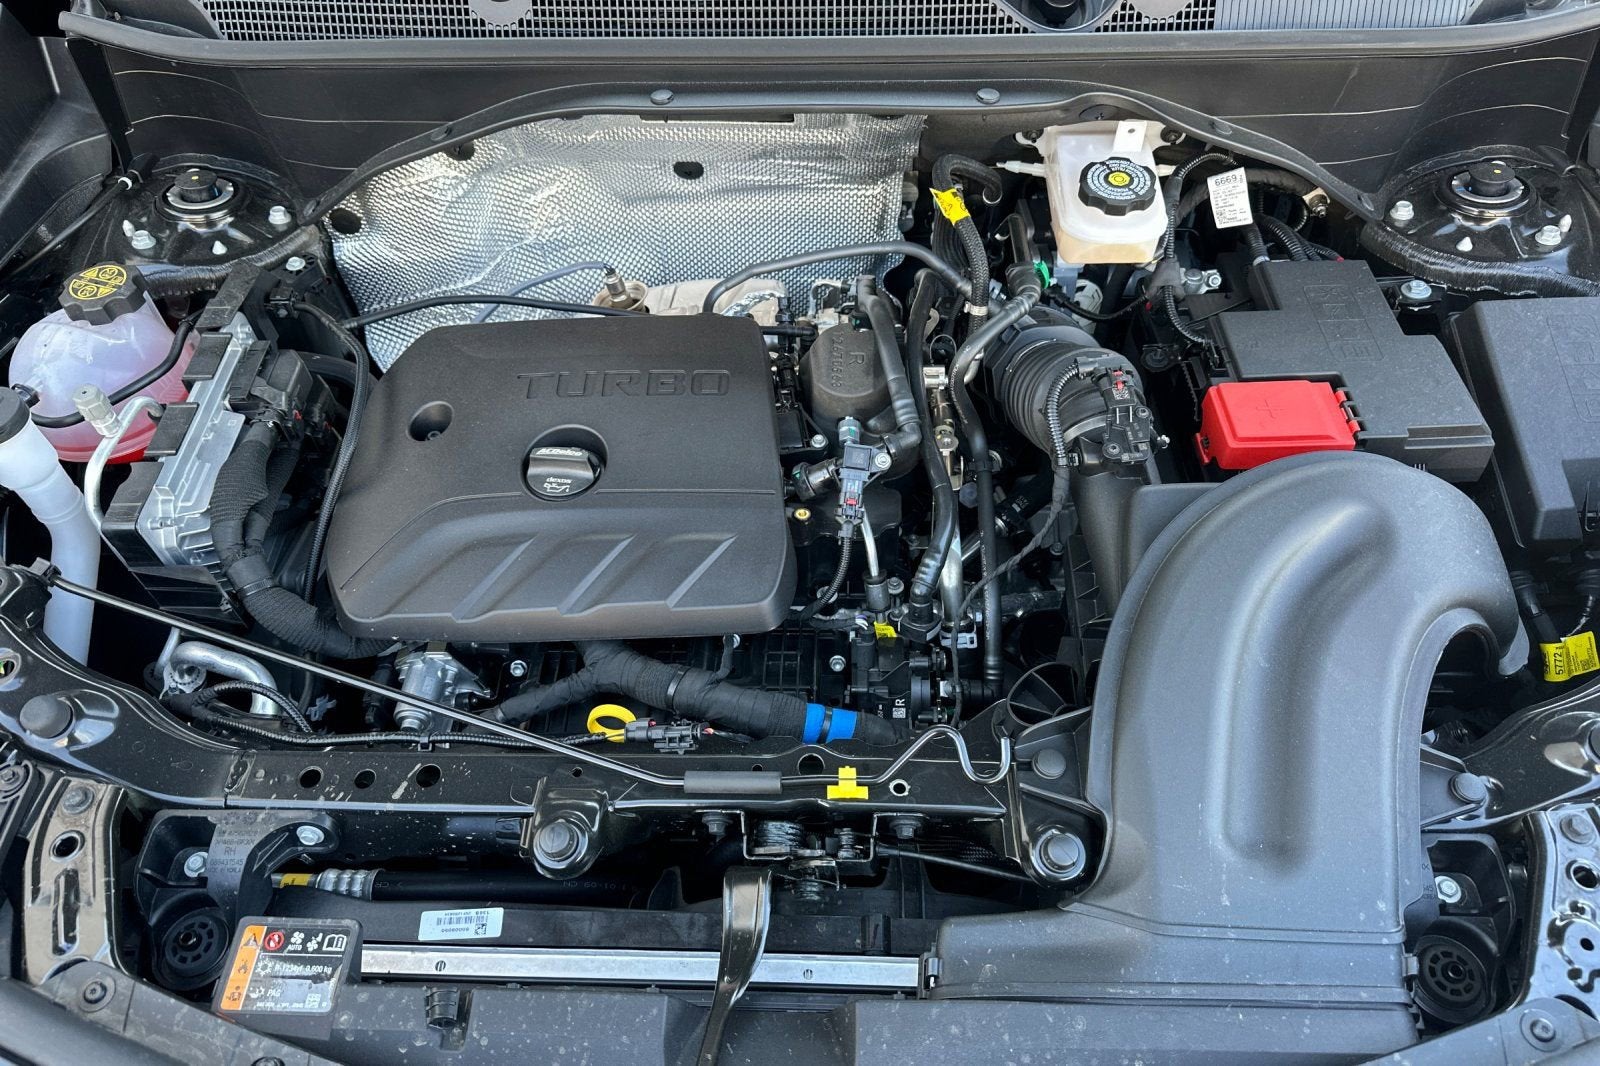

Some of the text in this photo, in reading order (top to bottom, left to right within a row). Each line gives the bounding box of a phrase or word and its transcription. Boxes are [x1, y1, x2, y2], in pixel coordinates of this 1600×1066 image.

[1215, 174, 1237, 187] 6669
[849, 352, 865, 365] R
[517, 369, 730, 399] TURBO
[536, 448, 583, 456] ACDelco
[1554, 652, 1564, 675] 5772
[895, 698, 905, 706] R
[224, 846, 237, 857] RH
[305, 964, 323, 973] 0.600
[267, 988, 281, 997] PAG
